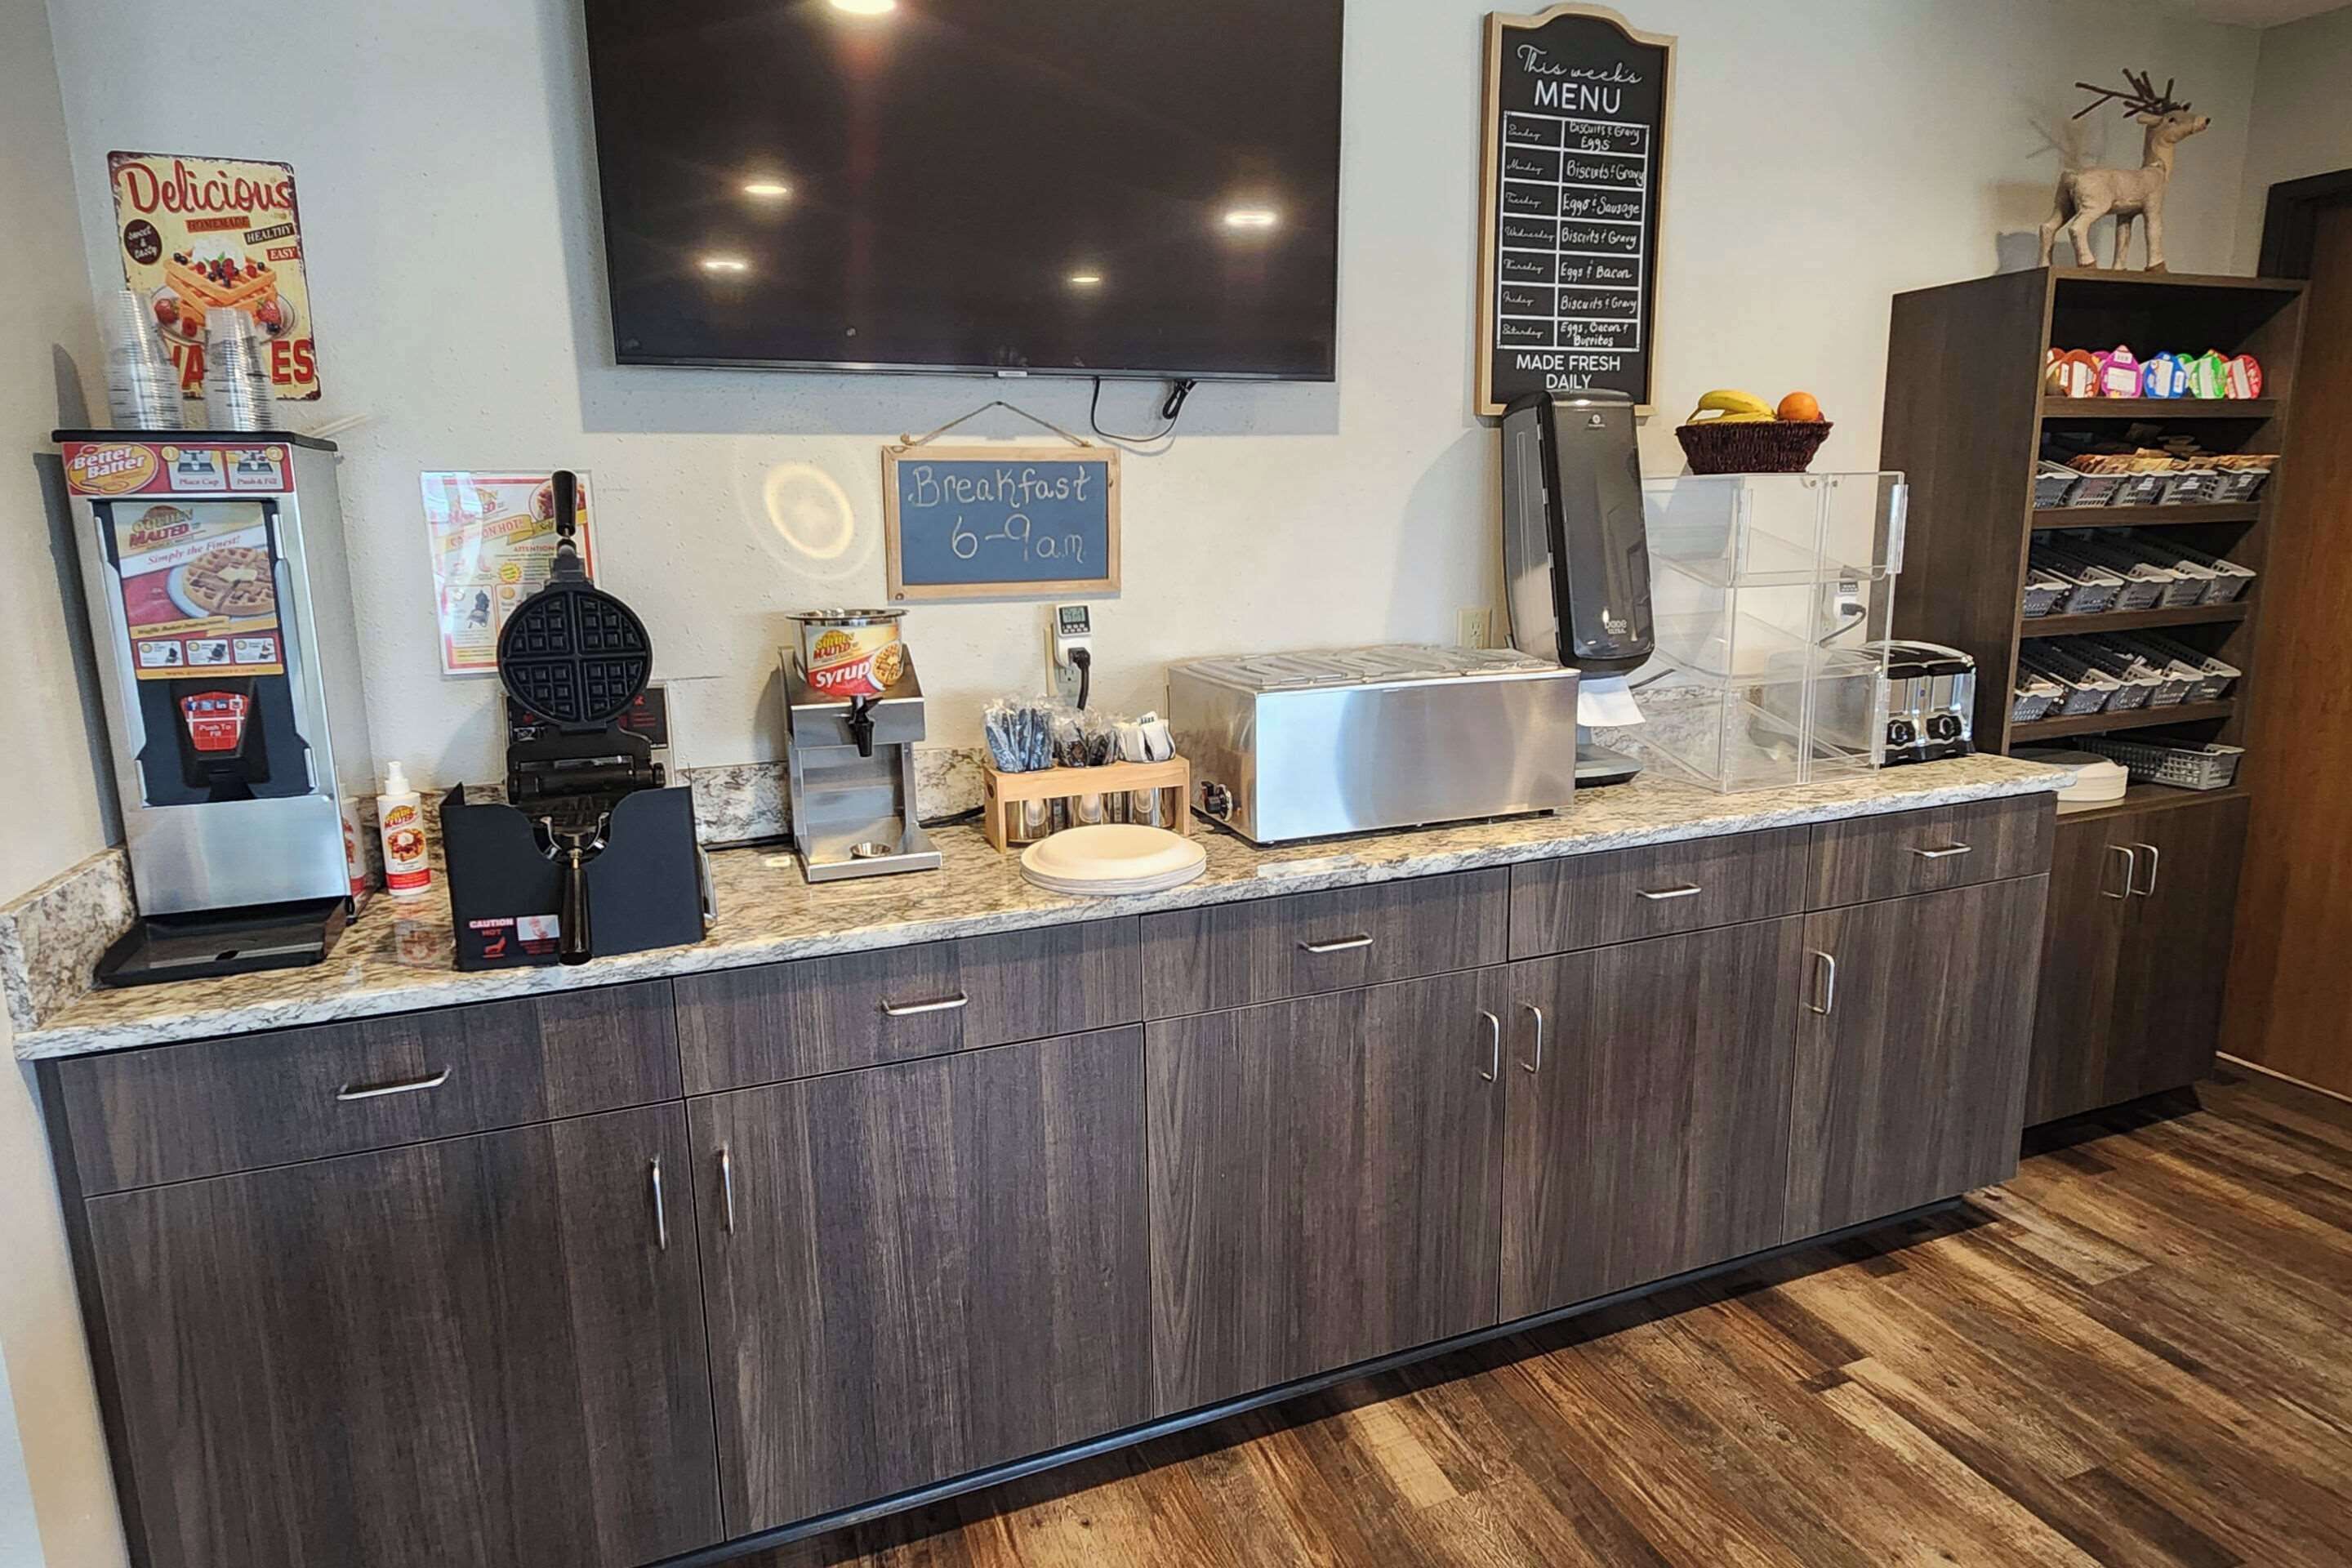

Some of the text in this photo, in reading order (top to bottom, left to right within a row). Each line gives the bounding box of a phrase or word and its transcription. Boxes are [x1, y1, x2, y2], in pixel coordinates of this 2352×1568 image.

[1517, 44, 1566, 75] This
[1534, 80, 1620, 114] MENU
[1569, 120, 1606, 136] Biscuits
[1614, 126, 1640, 145] Gravy
[1580, 136, 1611, 152] Eggs
[116, 159, 292, 214] Delicious
[1616, 163, 1645, 187] Gravy
[1562, 194, 1591, 216] Eggs
[1597, 196, 1640, 218] Sausage
[246, 224, 293, 243] HEALTHY
[1561, 226, 1599, 244] Biscuits
[1608, 230, 1637, 250] Gravy
[270, 249, 295, 260] EASY
[1561, 262, 1584, 282] Eggs
[1596, 265, 1633, 278] Bacon
[1561, 295, 1602, 310] Biscuits
[1611, 296, 1637, 314] Gravy
[1516, 354, 1621, 372] MADE FRESH
[1546, 373, 1592, 390] DAILY
[74, 447, 133, 470] Better
[87, 455, 146, 479] Batter
[204, 479, 219, 487] Cup
[908, 465, 1090, 508] Breakfast
[129, 523, 189, 547] MALTED
[148, 549, 185, 565] Simply
[186, 545, 203, 555] the
[815, 661, 870, 688] Syrup
[469, 918, 514, 929] CAUTION
